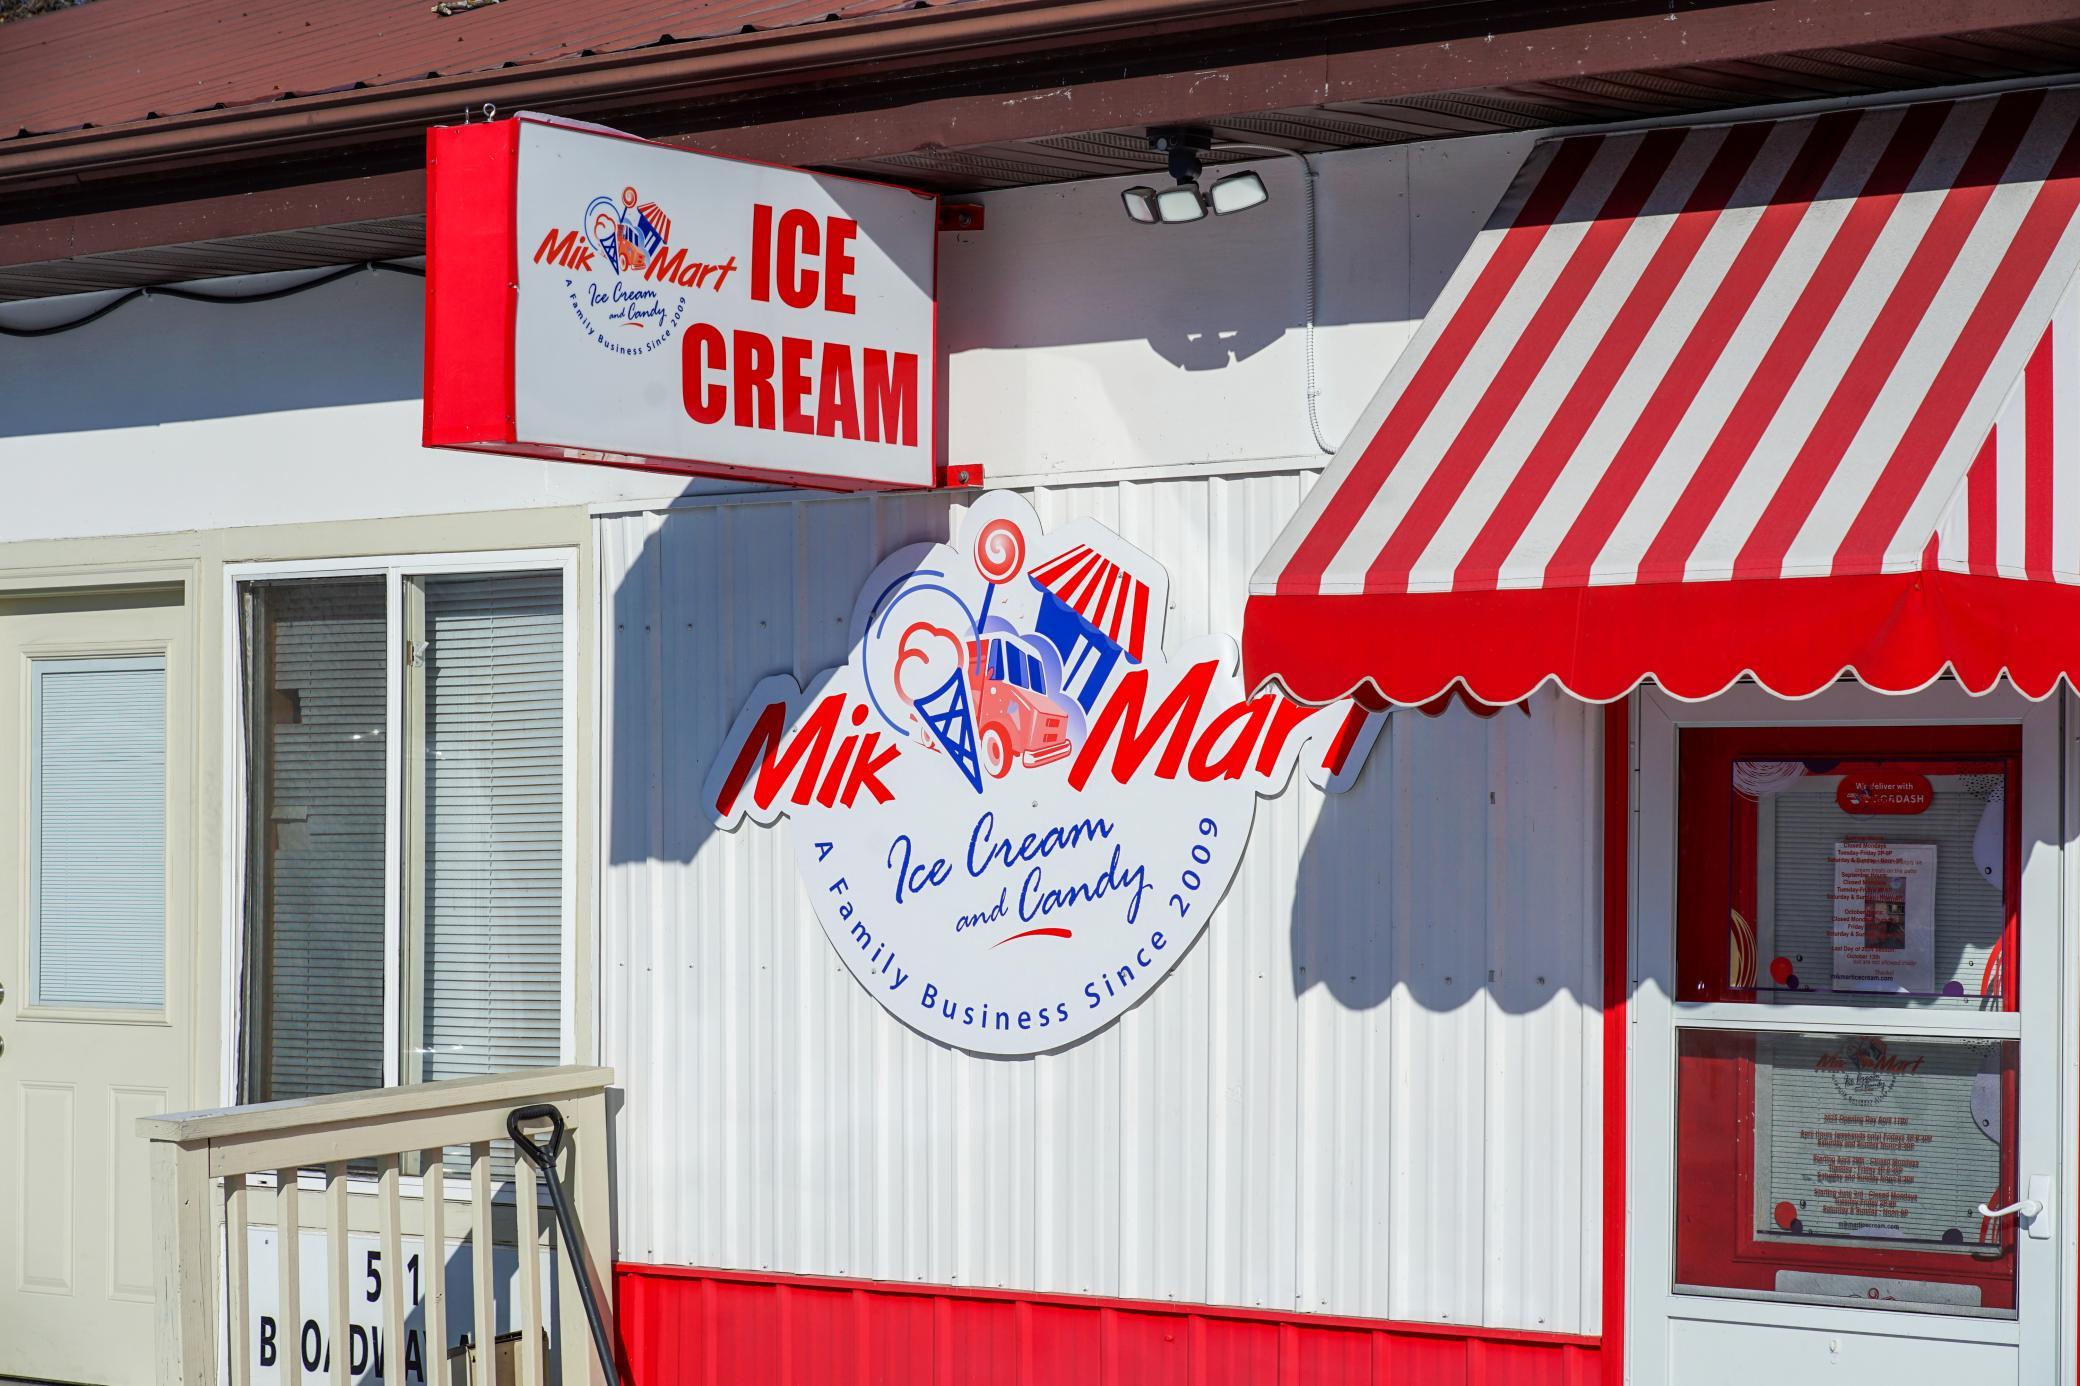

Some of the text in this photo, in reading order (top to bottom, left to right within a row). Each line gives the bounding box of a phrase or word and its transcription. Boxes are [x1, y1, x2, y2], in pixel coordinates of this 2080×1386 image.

[533, 228, 738, 293] Mik Mart
[588, 280, 657, 307] Ice Cream
[751, 204, 858, 315] ICE
[565, 279, 687, 356] A Family Business Since 2009
[608, 300, 667, 326] and Candy
[682, 322, 918, 448] CREAM
[715, 692, 902, 817] Mik
[1863, 795, 1924, 803] ORDASH
[887, 811, 1114, 904] Ice Cream
[955, 843, 1153, 932] and Candy
[814, 817, 1218, 1030] A Family Business Since 2009
[366, 1250, 419, 1306] 51
[260, 1315, 427, 1383] BODA
